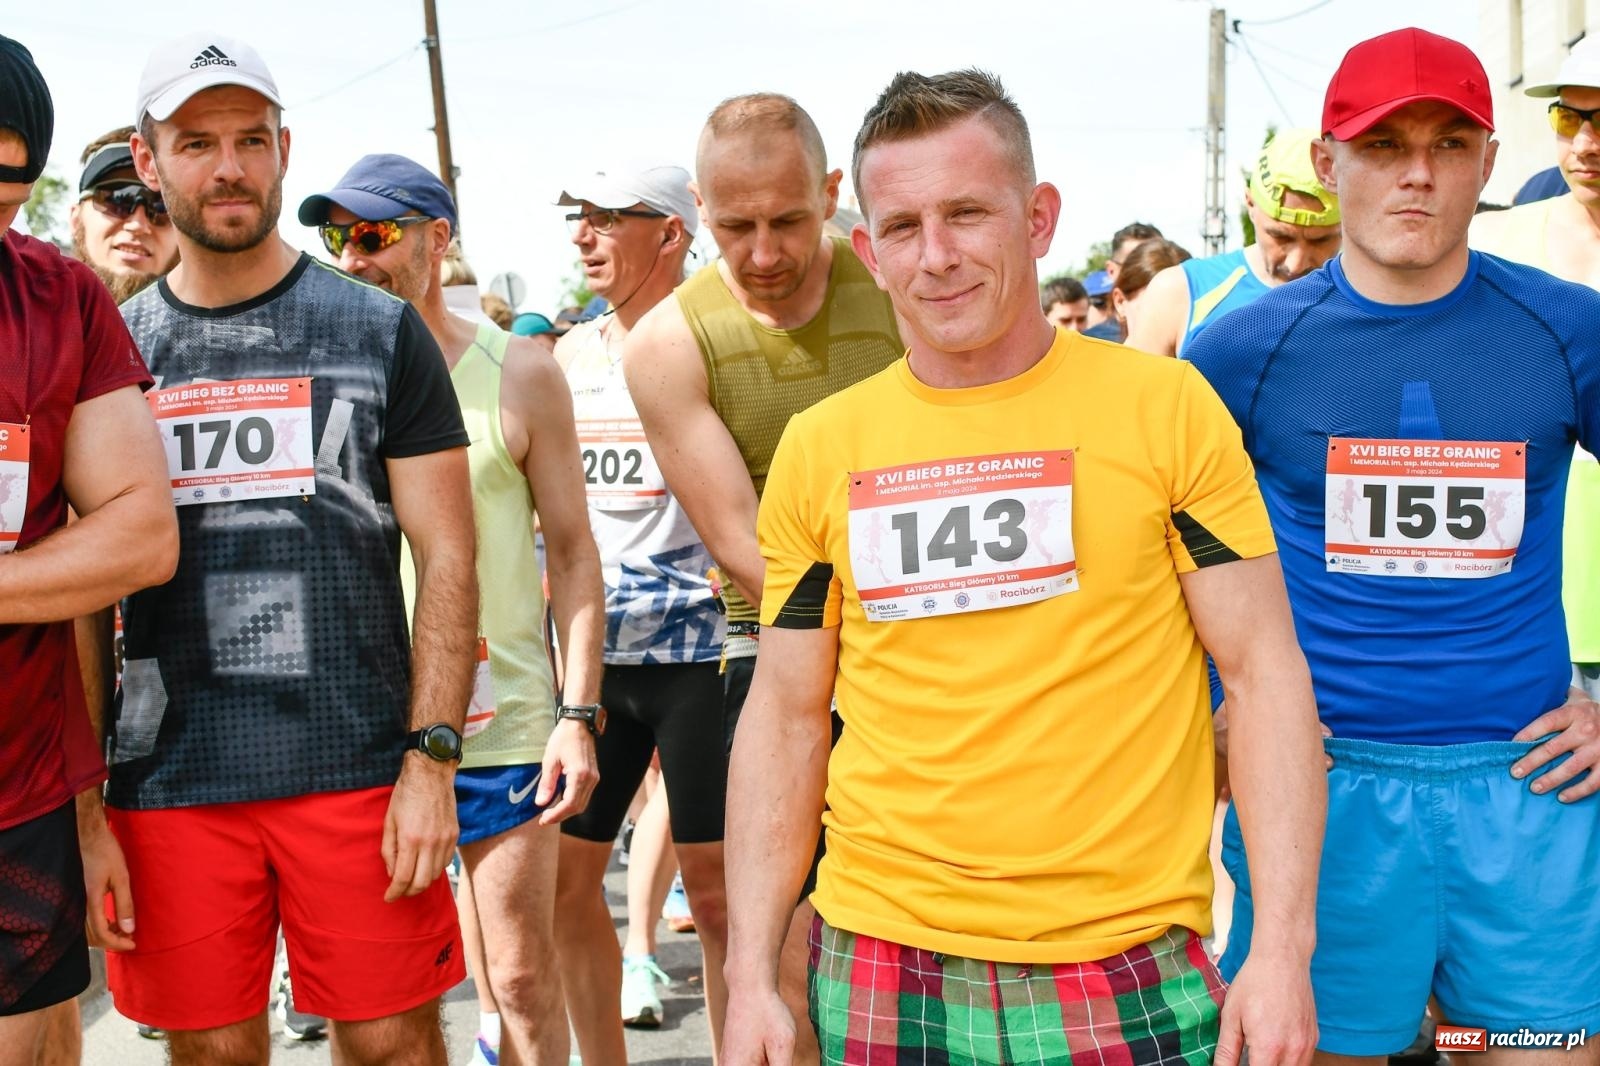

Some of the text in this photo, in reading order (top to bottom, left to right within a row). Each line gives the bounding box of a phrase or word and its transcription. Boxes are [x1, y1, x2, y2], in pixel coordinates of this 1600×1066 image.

[190, 57, 237, 69] adidas
[158, 383, 289, 404] XVI BIEG BEZ GRANIC
[173, 416, 275, 471] 170
[1349, 444, 1501, 459] XVI BIEG BEZ GRANIC
[582, 448, 643, 484] 202
[875, 457, 1045, 486] XVI BIEG BEZ GRANIC
[1450, 461, 1500, 469] Kędzierskiego
[986, 471, 1042, 482] Kędzierskiego
[254, 484, 289, 492] Racibórz
[943, 488, 960, 496] maja
[1363, 484, 1486, 540] 155
[891, 498, 1027, 575] 143
[1369, 548, 1410, 556] KATEGORIA:
[1411, 549, 1426, 557] Bieg
[1427, 549, 1453, 558] Główny
[1454, 563, 1492, 571] Racibórz
[904, 584, 948, 594] KATEGORIA:
[949, 581, 965, 589] Bieg
[967, 577, 996, 585] Główny
[1000, 585, 1046, 598] Racibórz
[877, 603, 898, 611] POLICJA
